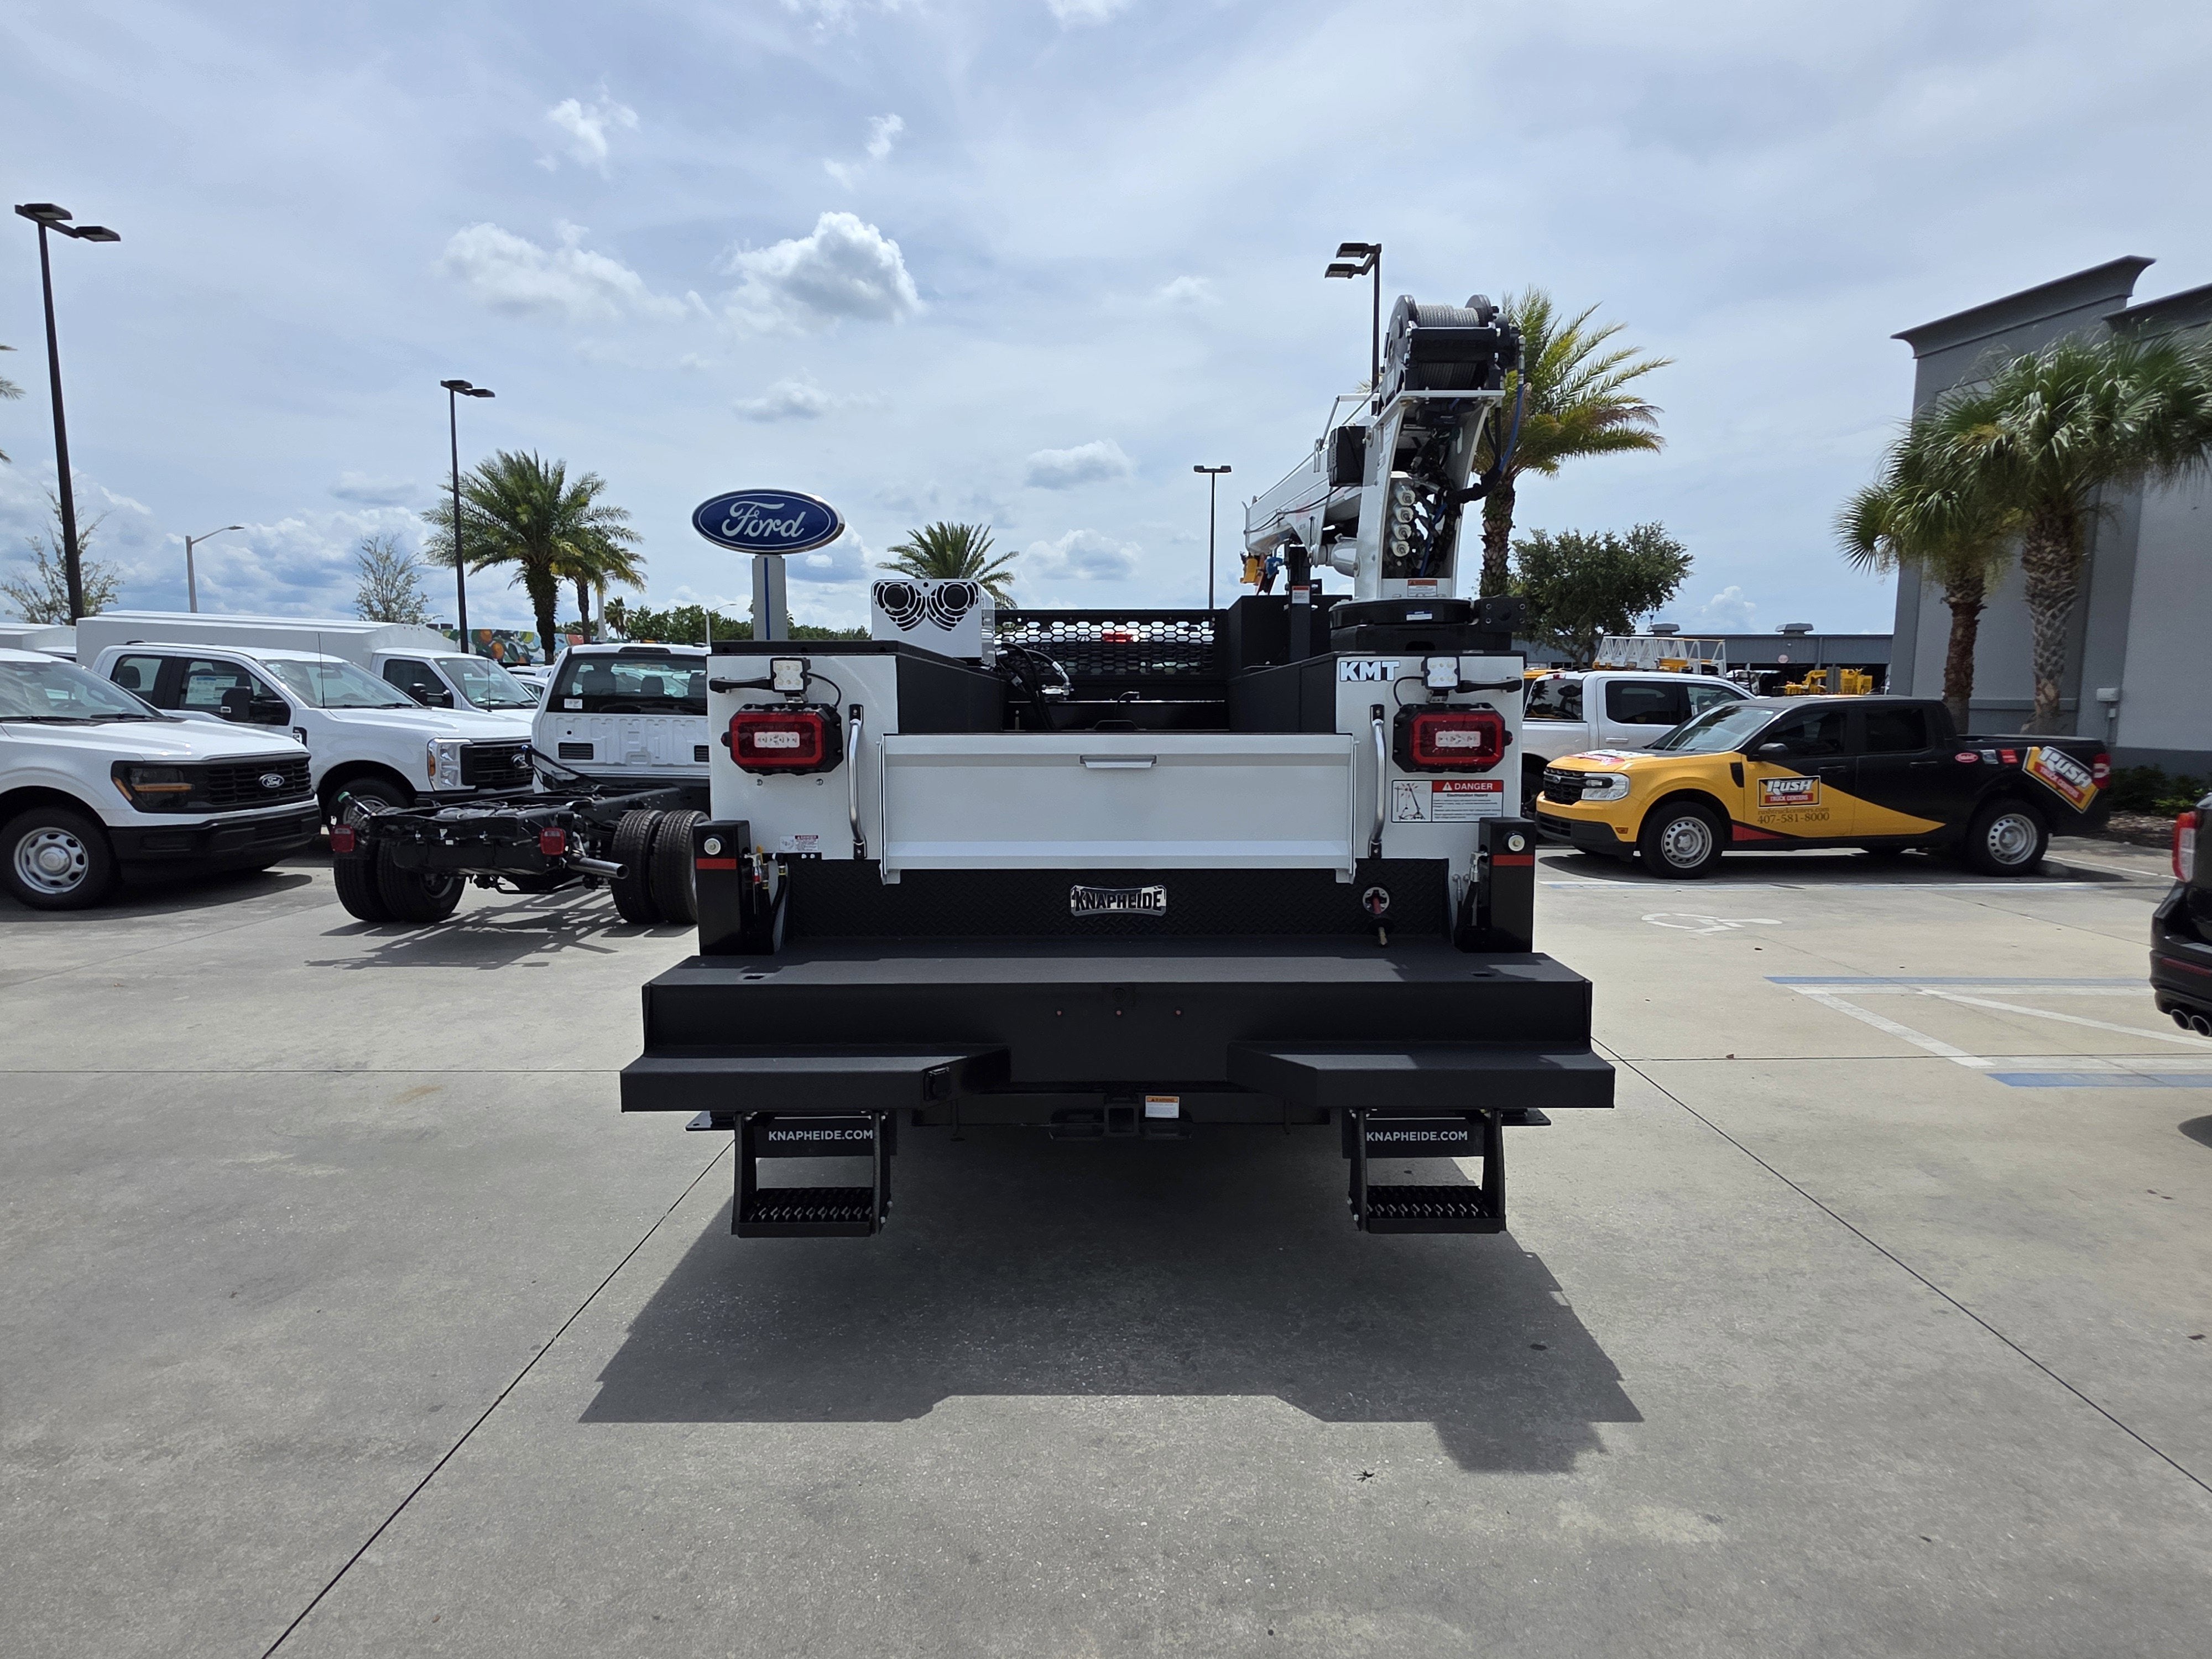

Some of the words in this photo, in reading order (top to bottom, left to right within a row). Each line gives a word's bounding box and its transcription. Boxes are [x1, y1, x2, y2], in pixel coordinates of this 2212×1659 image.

[722, 501, 806, 538] Ford
[1340, 661, 1400, 681] KMT
[1767, 780, 1813, 795] RUSH
[1757, 812, 1830, 824] 407-581-8000
[1075, 889, 1162, 911] KNAPHEIDE
[769, 1129, 873, 1141] KNAPHEIDE.COM
[1366, 1131, 1468, 1142] KNAPHEIDE.COM
